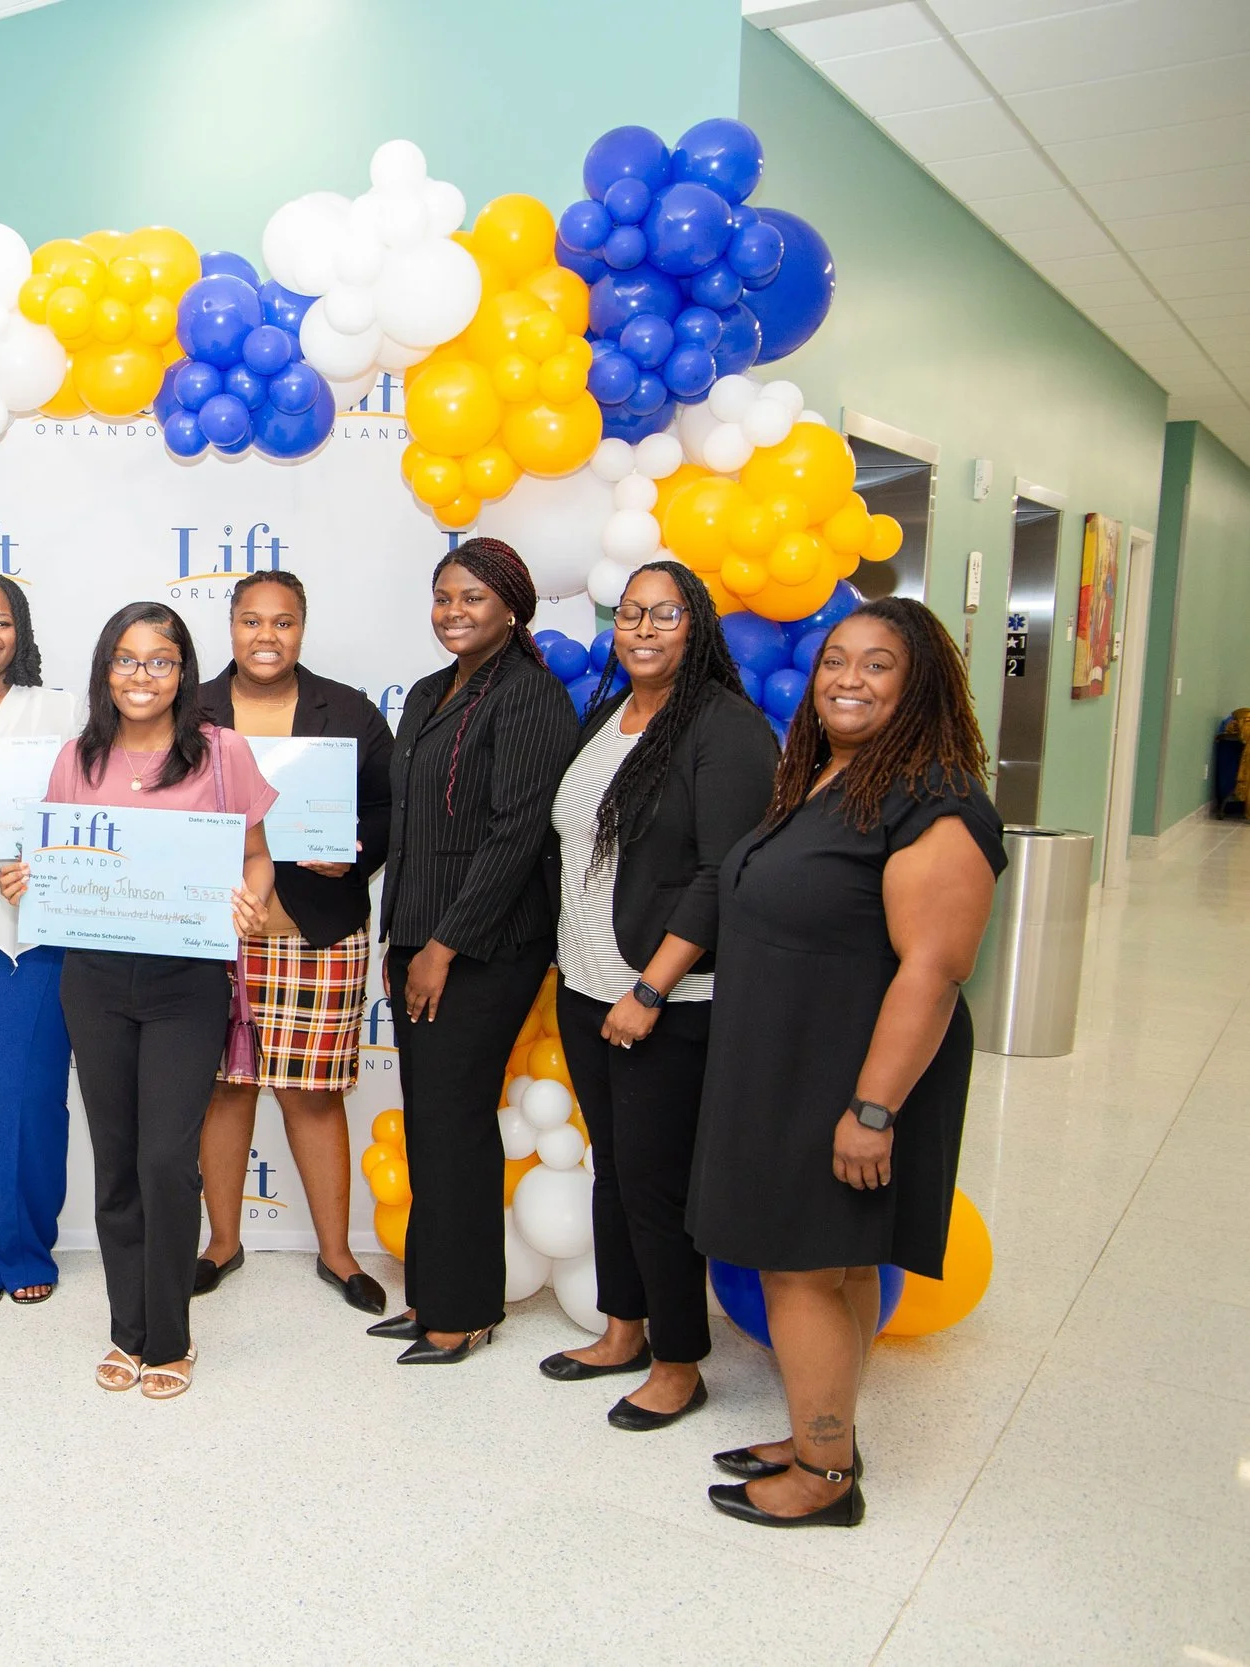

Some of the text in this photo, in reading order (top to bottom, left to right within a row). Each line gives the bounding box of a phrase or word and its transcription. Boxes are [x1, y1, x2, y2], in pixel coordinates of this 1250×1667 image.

[36, 424, 157, 437] ORLANDO
[171, 523, 289, 579] Lift
[170, 587, 233, 599] ORLA
[1020, 635, 1026, 649] 1
[1007, 659, 1017, 677] 2
[37, 811, 121, 852] Lift
[34, 854, 122, 868] ORLANDO
[60, 875, 165, 902] Courtney Johnson
[38, 900, 63, 914] Three
[117, 905, 148, 919] hundred
[101, 933, 136, 941] Scholarship
[182, 937, 200, 947] Eddy
